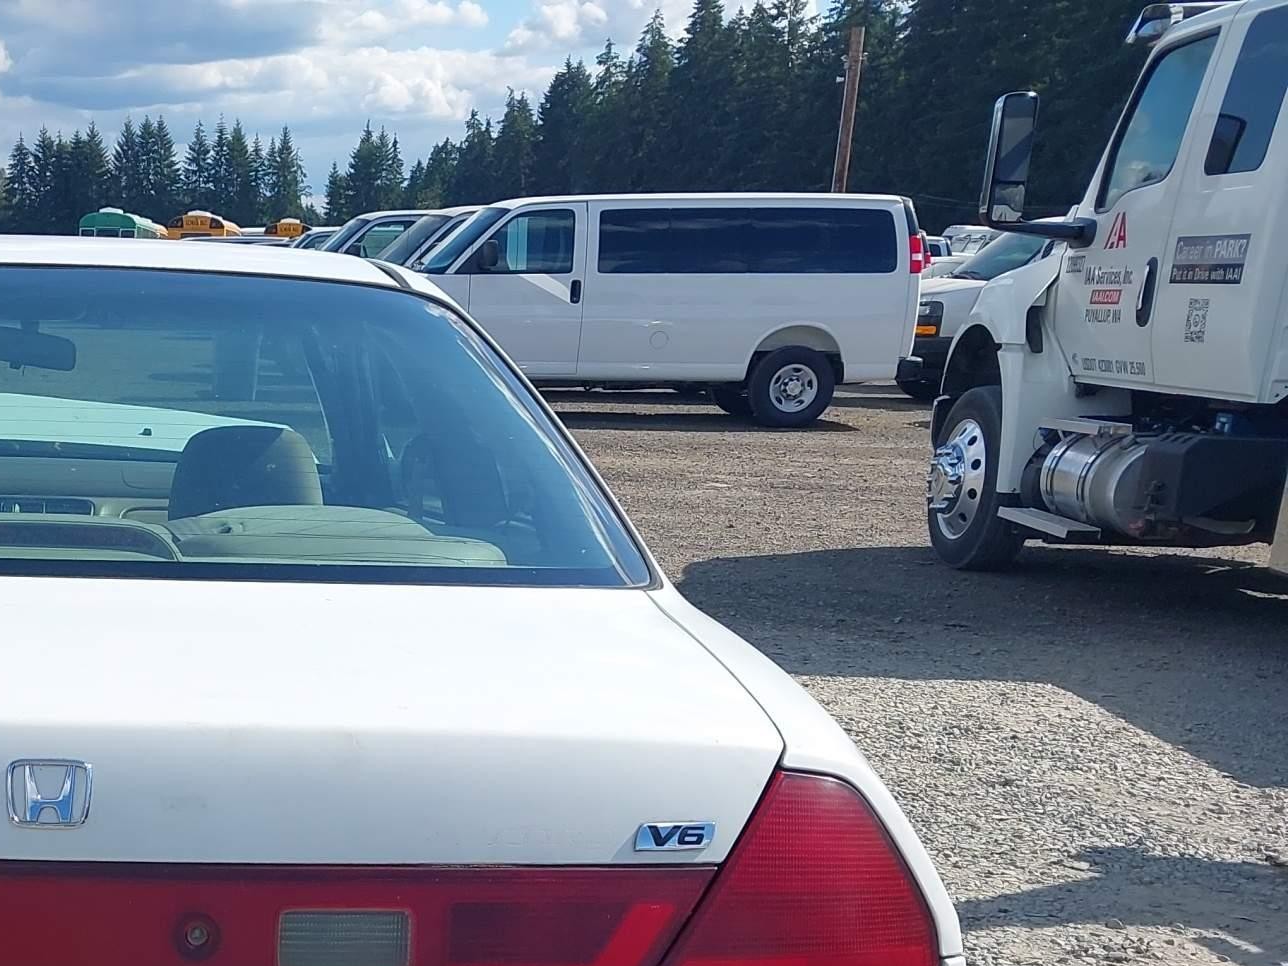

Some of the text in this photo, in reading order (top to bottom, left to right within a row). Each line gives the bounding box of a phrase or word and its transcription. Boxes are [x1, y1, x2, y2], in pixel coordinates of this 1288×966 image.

[1176, 240, 1247, 259] Career in PARK?
[1084, 266, 1096, 285] IAA
[1096, 266, 1122, 287] Services,
[1210, 267, 1225, 280] with
[647, 825, 706, 847] V6
